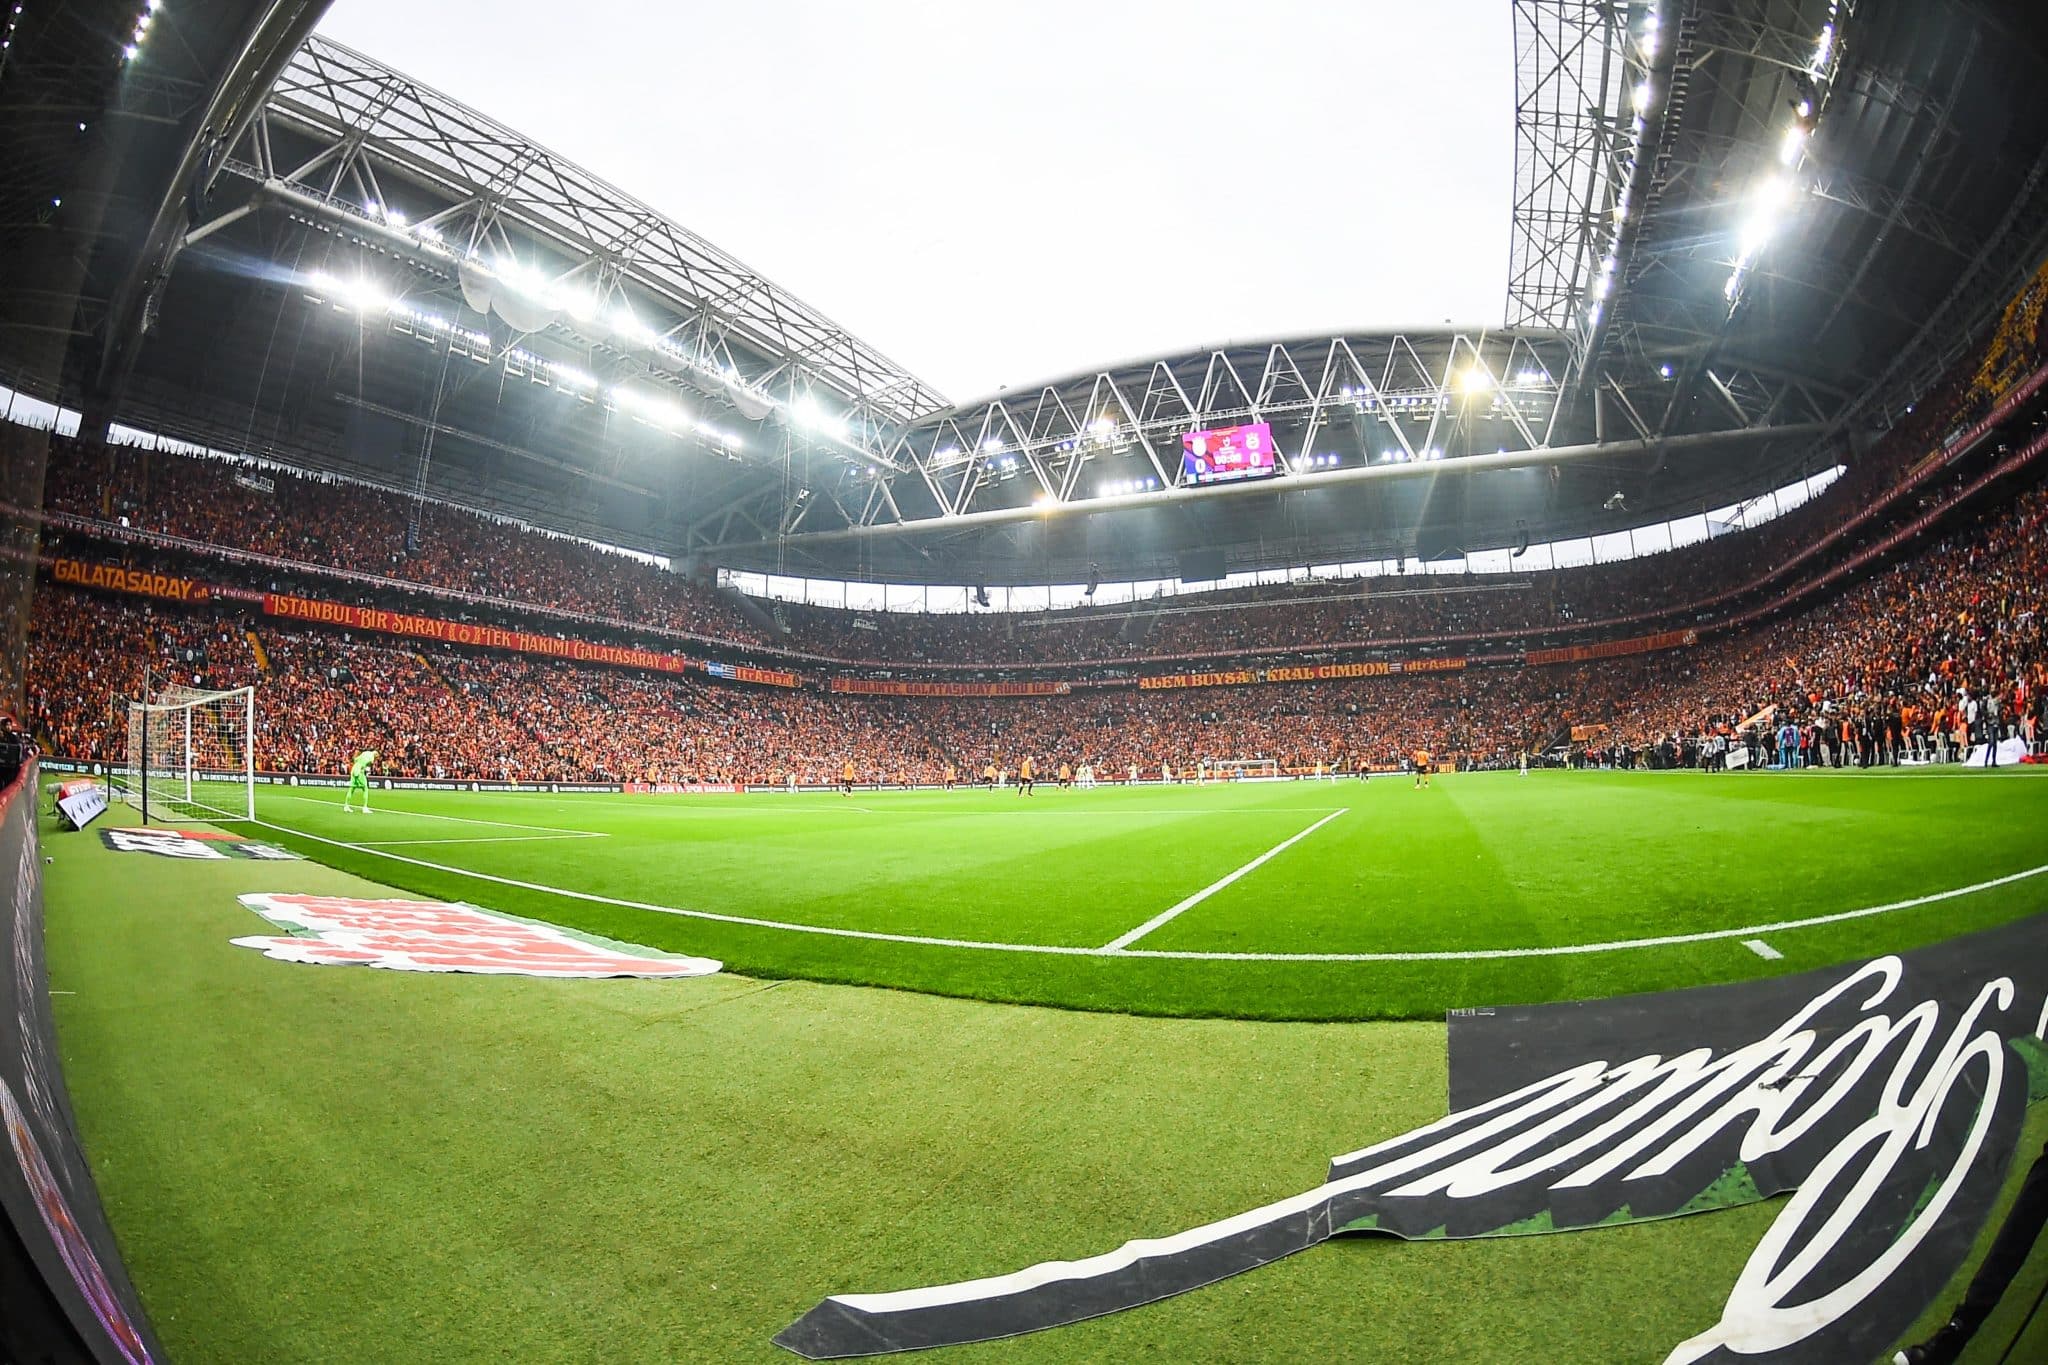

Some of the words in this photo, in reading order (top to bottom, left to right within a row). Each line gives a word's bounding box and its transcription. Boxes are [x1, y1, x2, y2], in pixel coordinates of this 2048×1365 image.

[54, 559, 193, 599] GALATASARAY
[392, 613, 445, 637] SARAY
[481, 629, 512, 647] TEK
[574, 641, 661, 669] GALATASARAY
[1139, 677, 1187, 689] ALEM
[1266, 668, 1314, 682] KRAL
